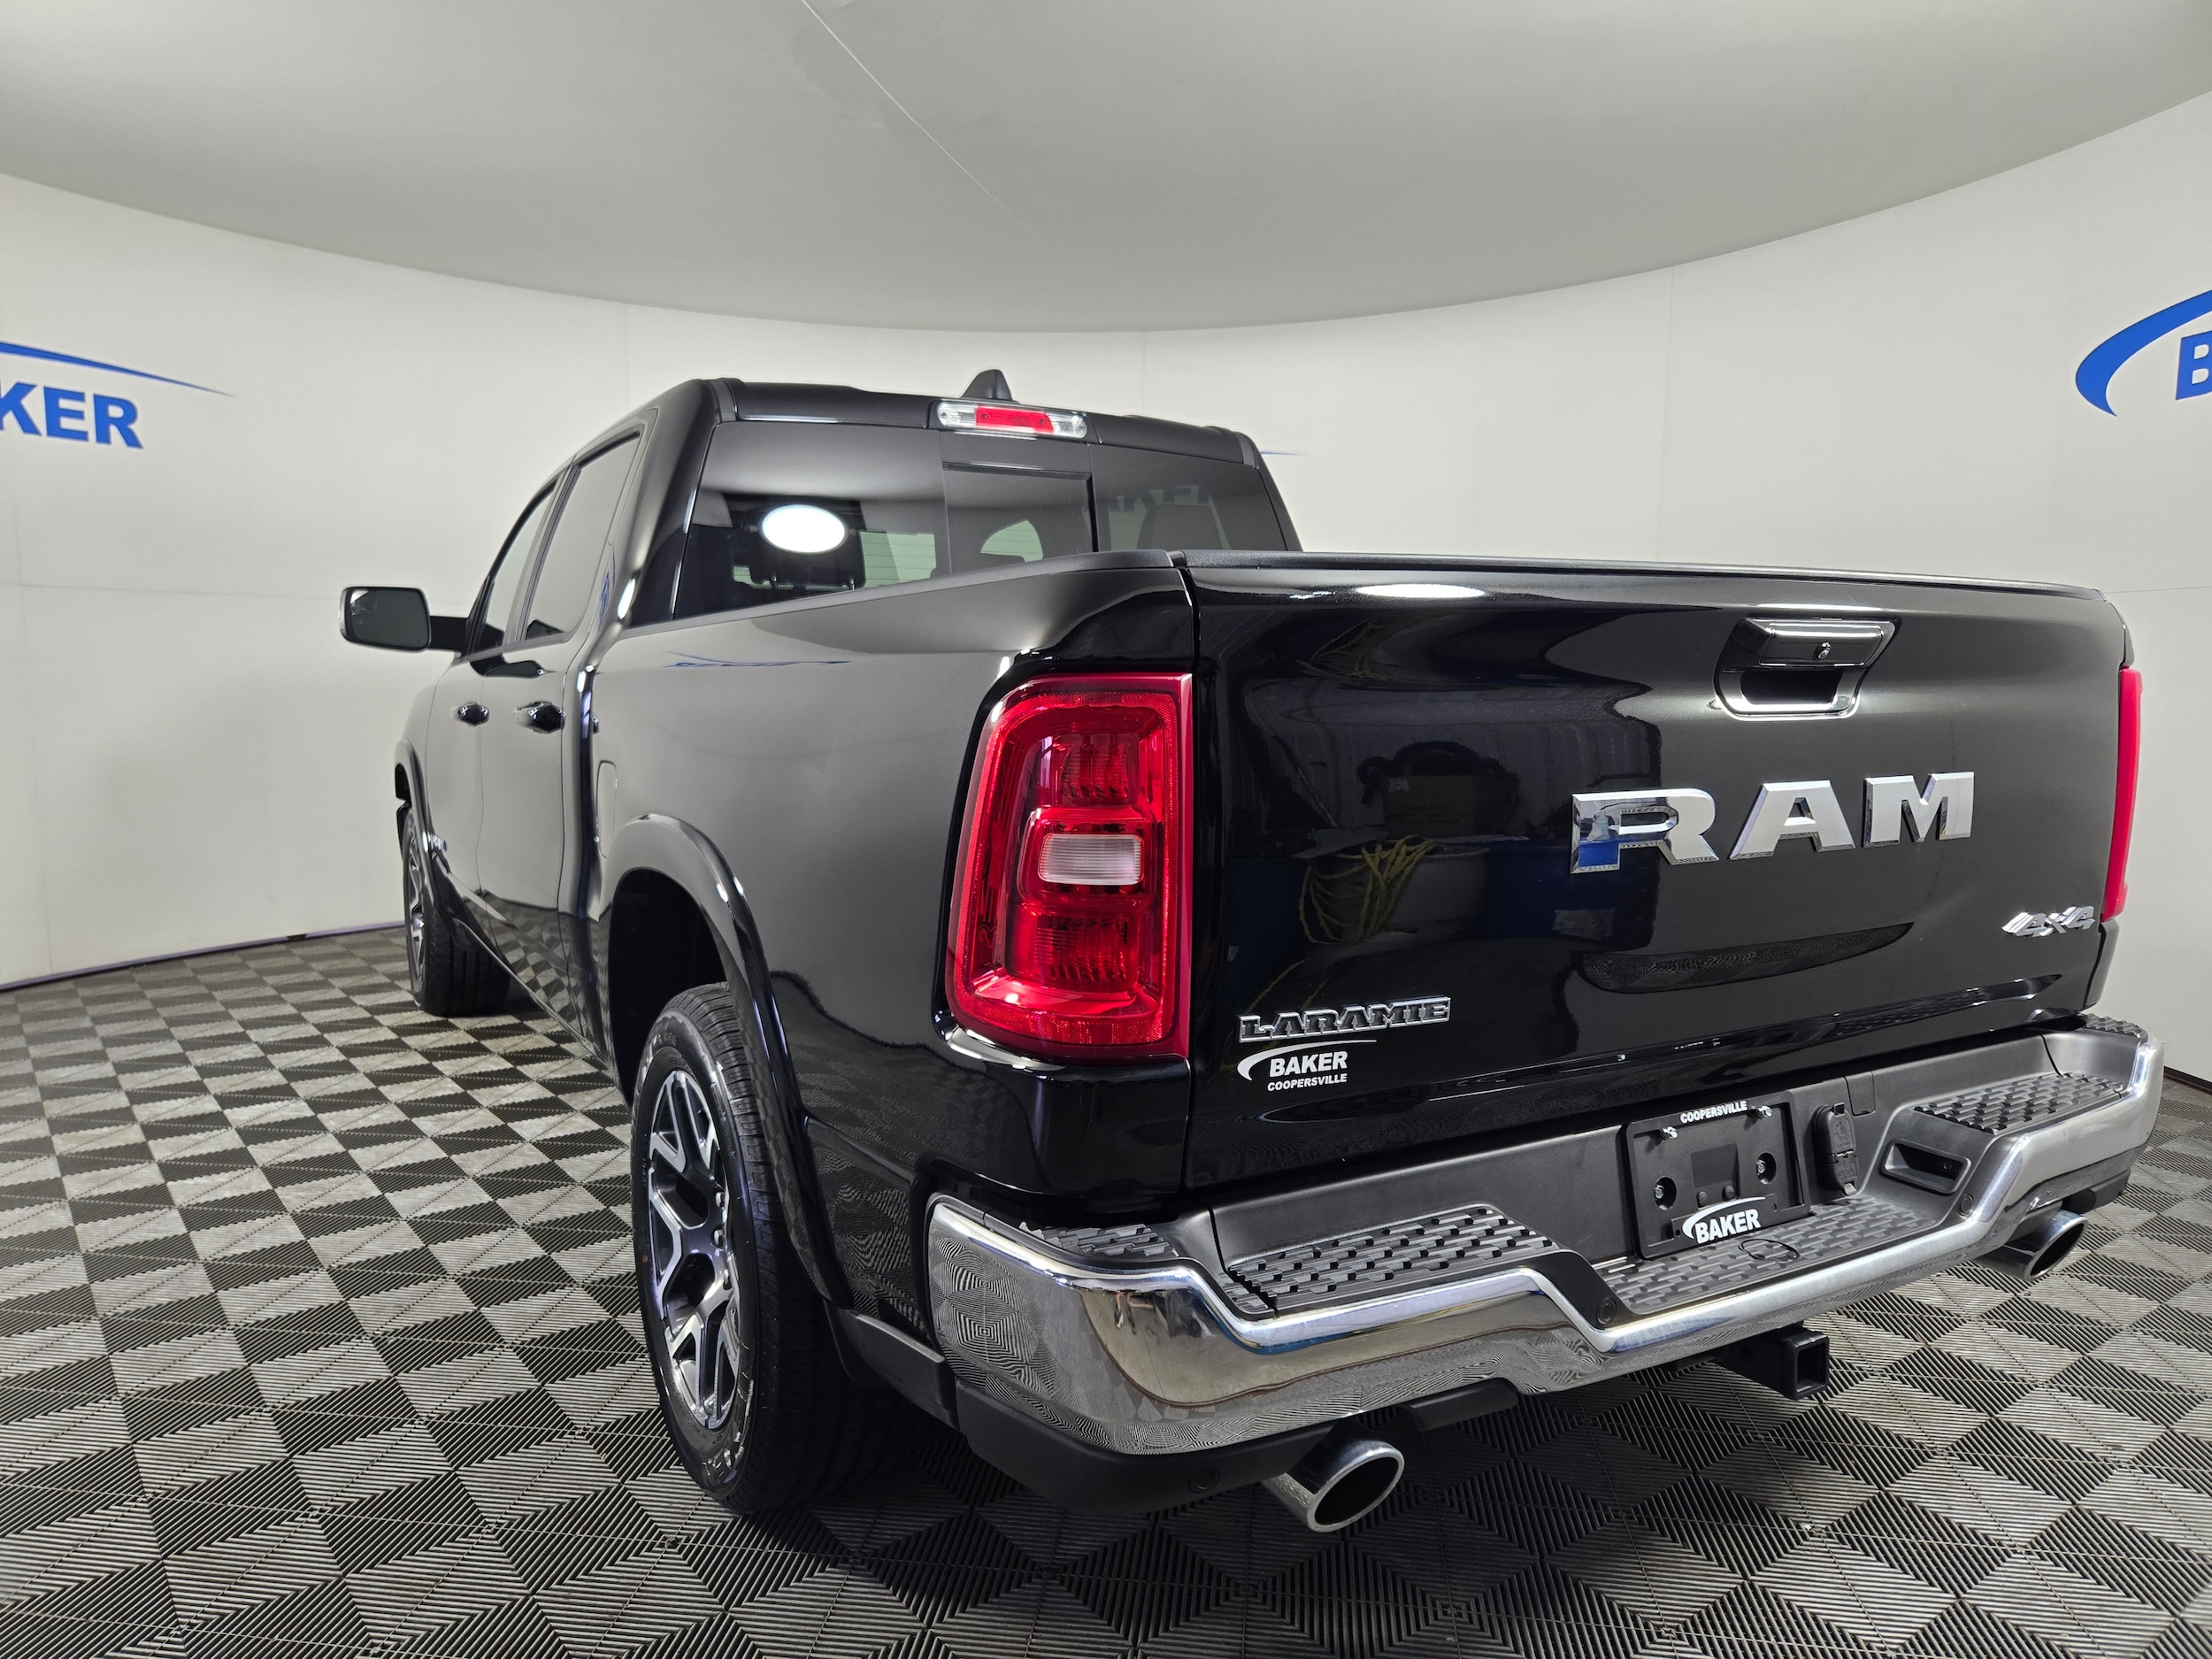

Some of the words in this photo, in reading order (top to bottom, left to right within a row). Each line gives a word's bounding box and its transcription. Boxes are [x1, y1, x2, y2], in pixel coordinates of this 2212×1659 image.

[1571, 771, 1974, 873] RAM
[1239, 995, 1451, 1043] LARAMIE
[1270, 1050, 1348, 1078] BAKER
[1267, 1072, 1348, 1091] COOPERSVILLE
[1680, 1100, 1748, 1124] COOPERSVILLE
[1694, 1209, 1761, 1244] BAKER
